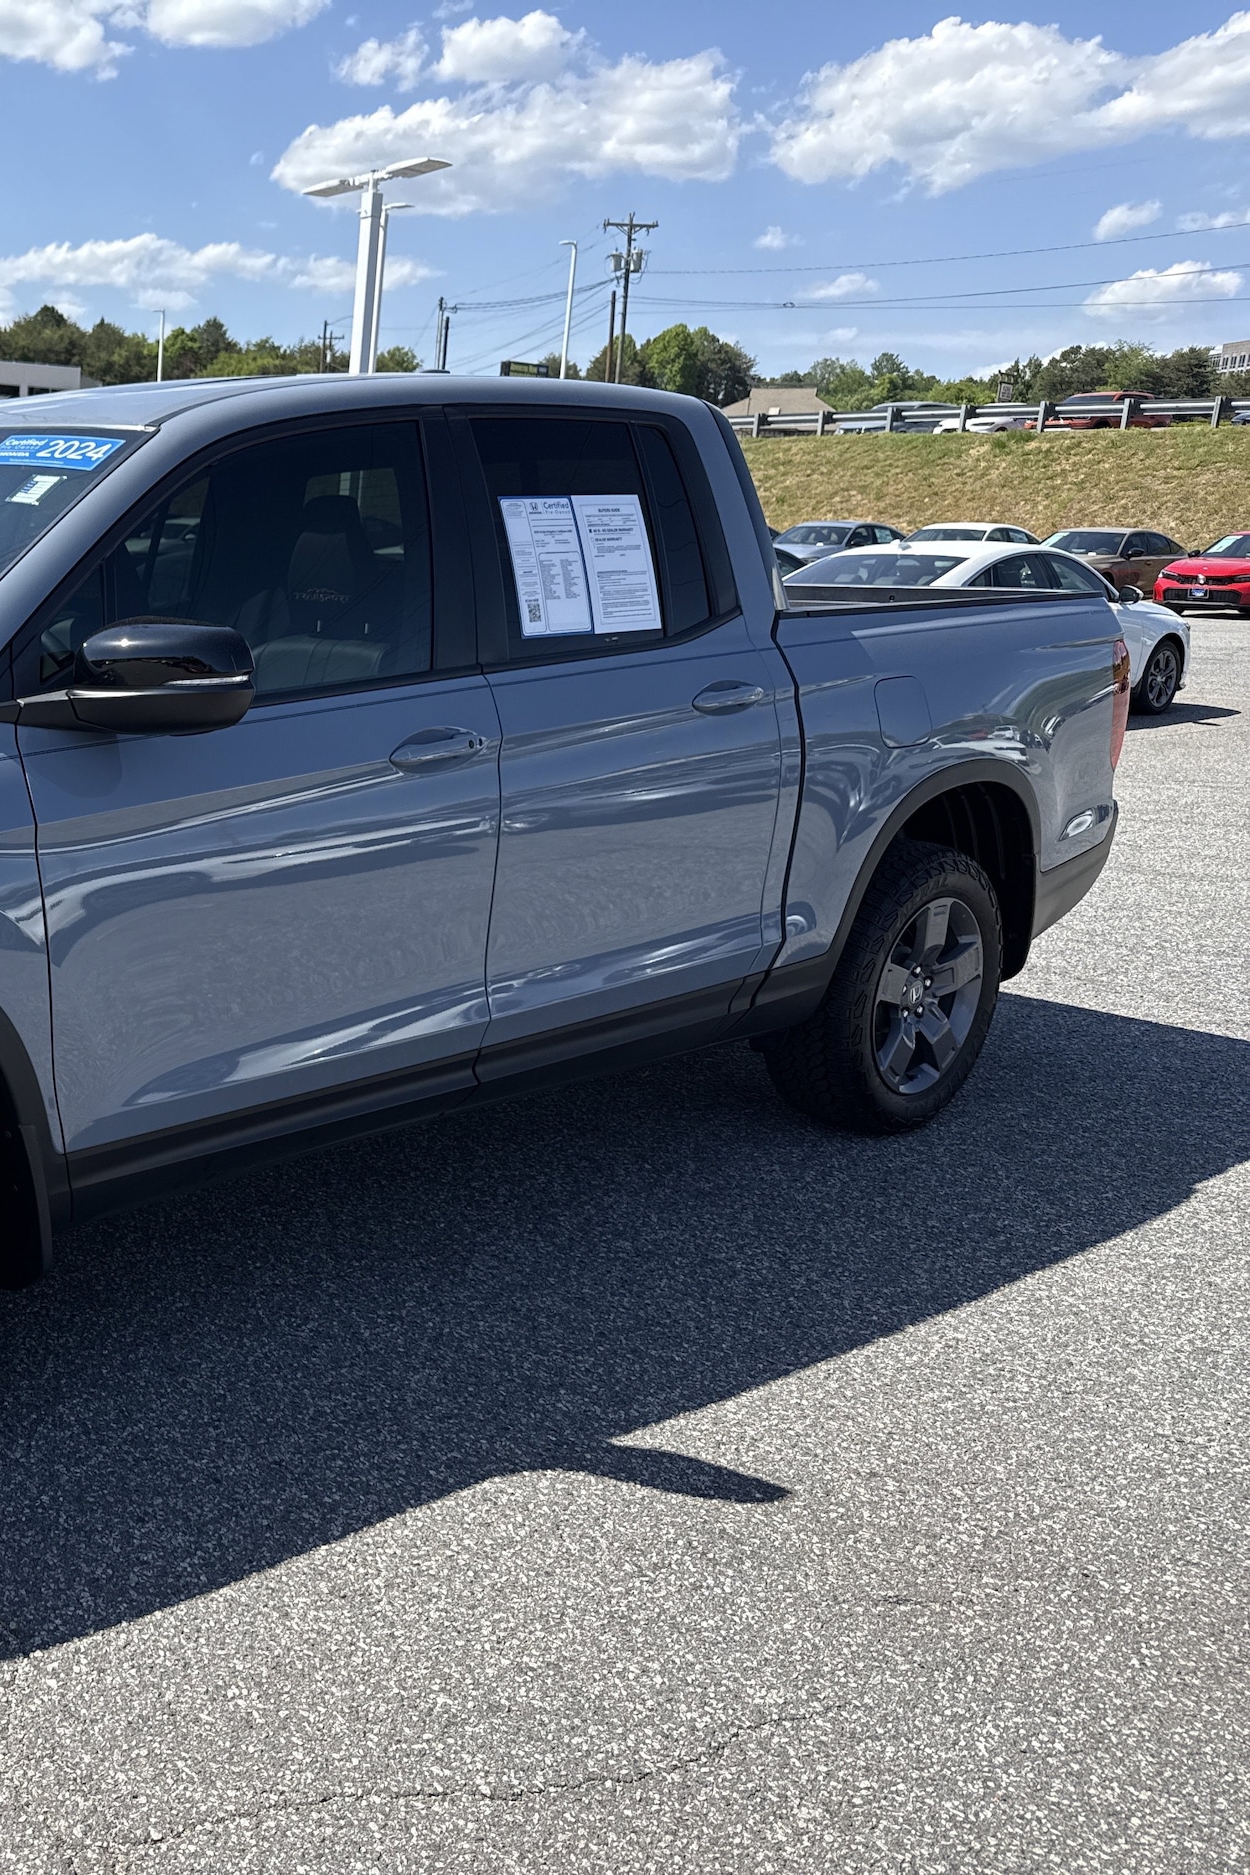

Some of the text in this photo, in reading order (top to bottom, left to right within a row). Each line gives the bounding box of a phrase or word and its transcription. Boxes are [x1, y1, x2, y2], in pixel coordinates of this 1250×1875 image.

[5, 438, 48, 446] Certified
[36, 439, 112, 461] 2024
[543, 501, 569, 510] Certified
